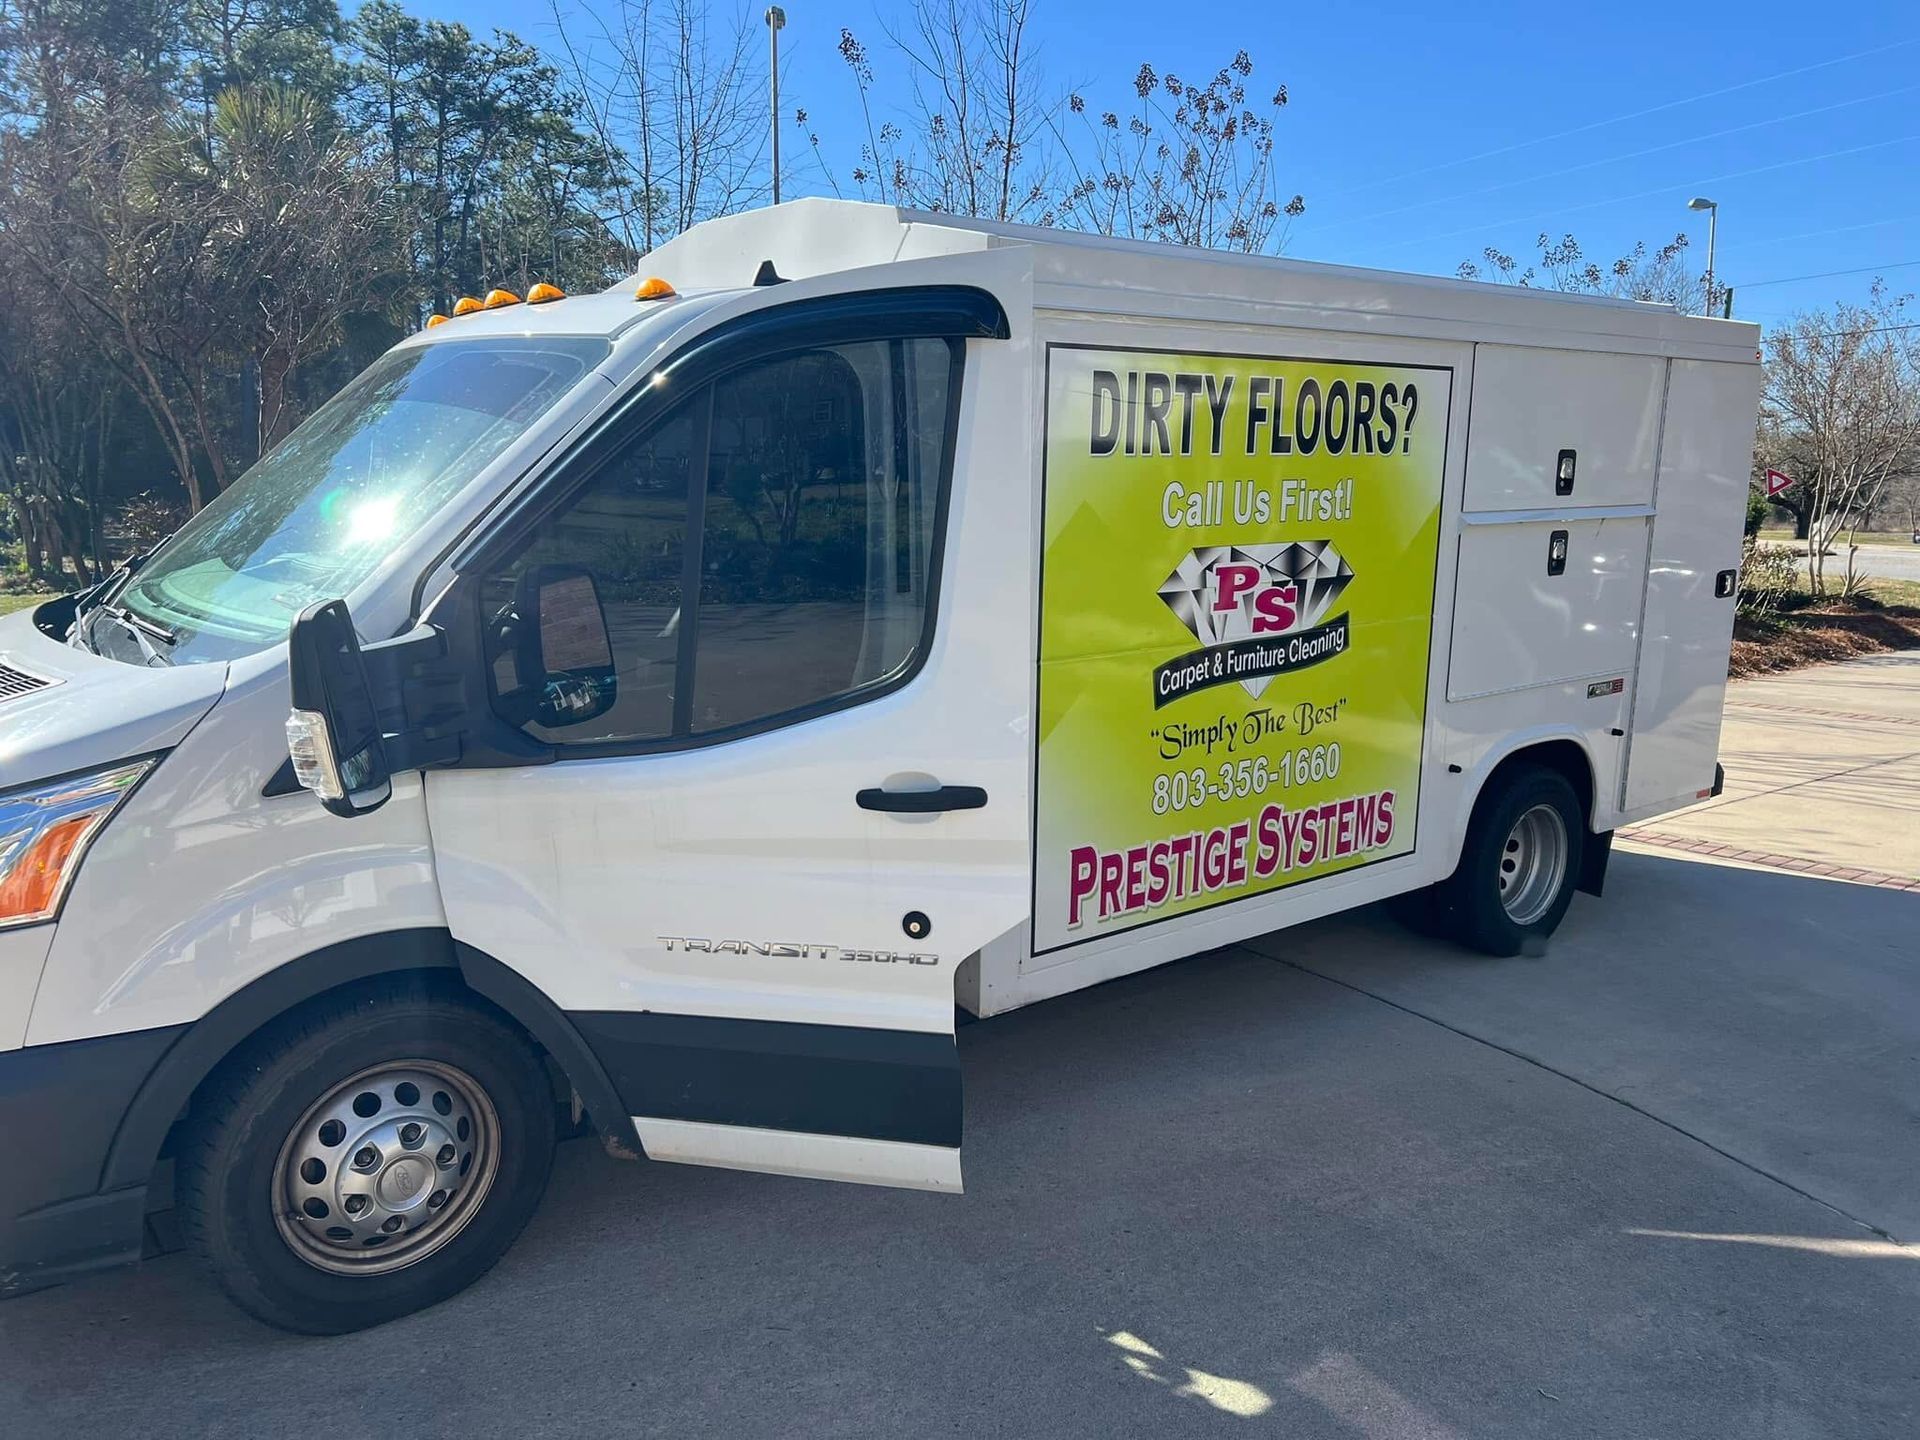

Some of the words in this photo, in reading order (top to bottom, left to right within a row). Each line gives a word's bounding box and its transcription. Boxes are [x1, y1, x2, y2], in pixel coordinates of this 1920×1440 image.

[1090, 370, 1234, 457] DIRTY
[1245, 376, 1418, 457] FLOORS?
[1162, 480, 1223, 528] Call
[1233, 480, 1271, 525] Us
[1280, 478, 1353, 522] First!
[1160, 657, 1210, 696] Carpet
[1213, 652, 1223, 677] &
[1227, 644, 1285, 674] Furniture
[1288, 625, 1345, 664] Cleaning
[1244, 707, 1286, 744] The
[1152, 742, 1341, 815] 803-356-1660
[1068, 821, 1250, 928] PRESTIGE
[1255, 790, 1397, 876] SYSTEMS
[656, 936, 839, 960] TRANSIT
